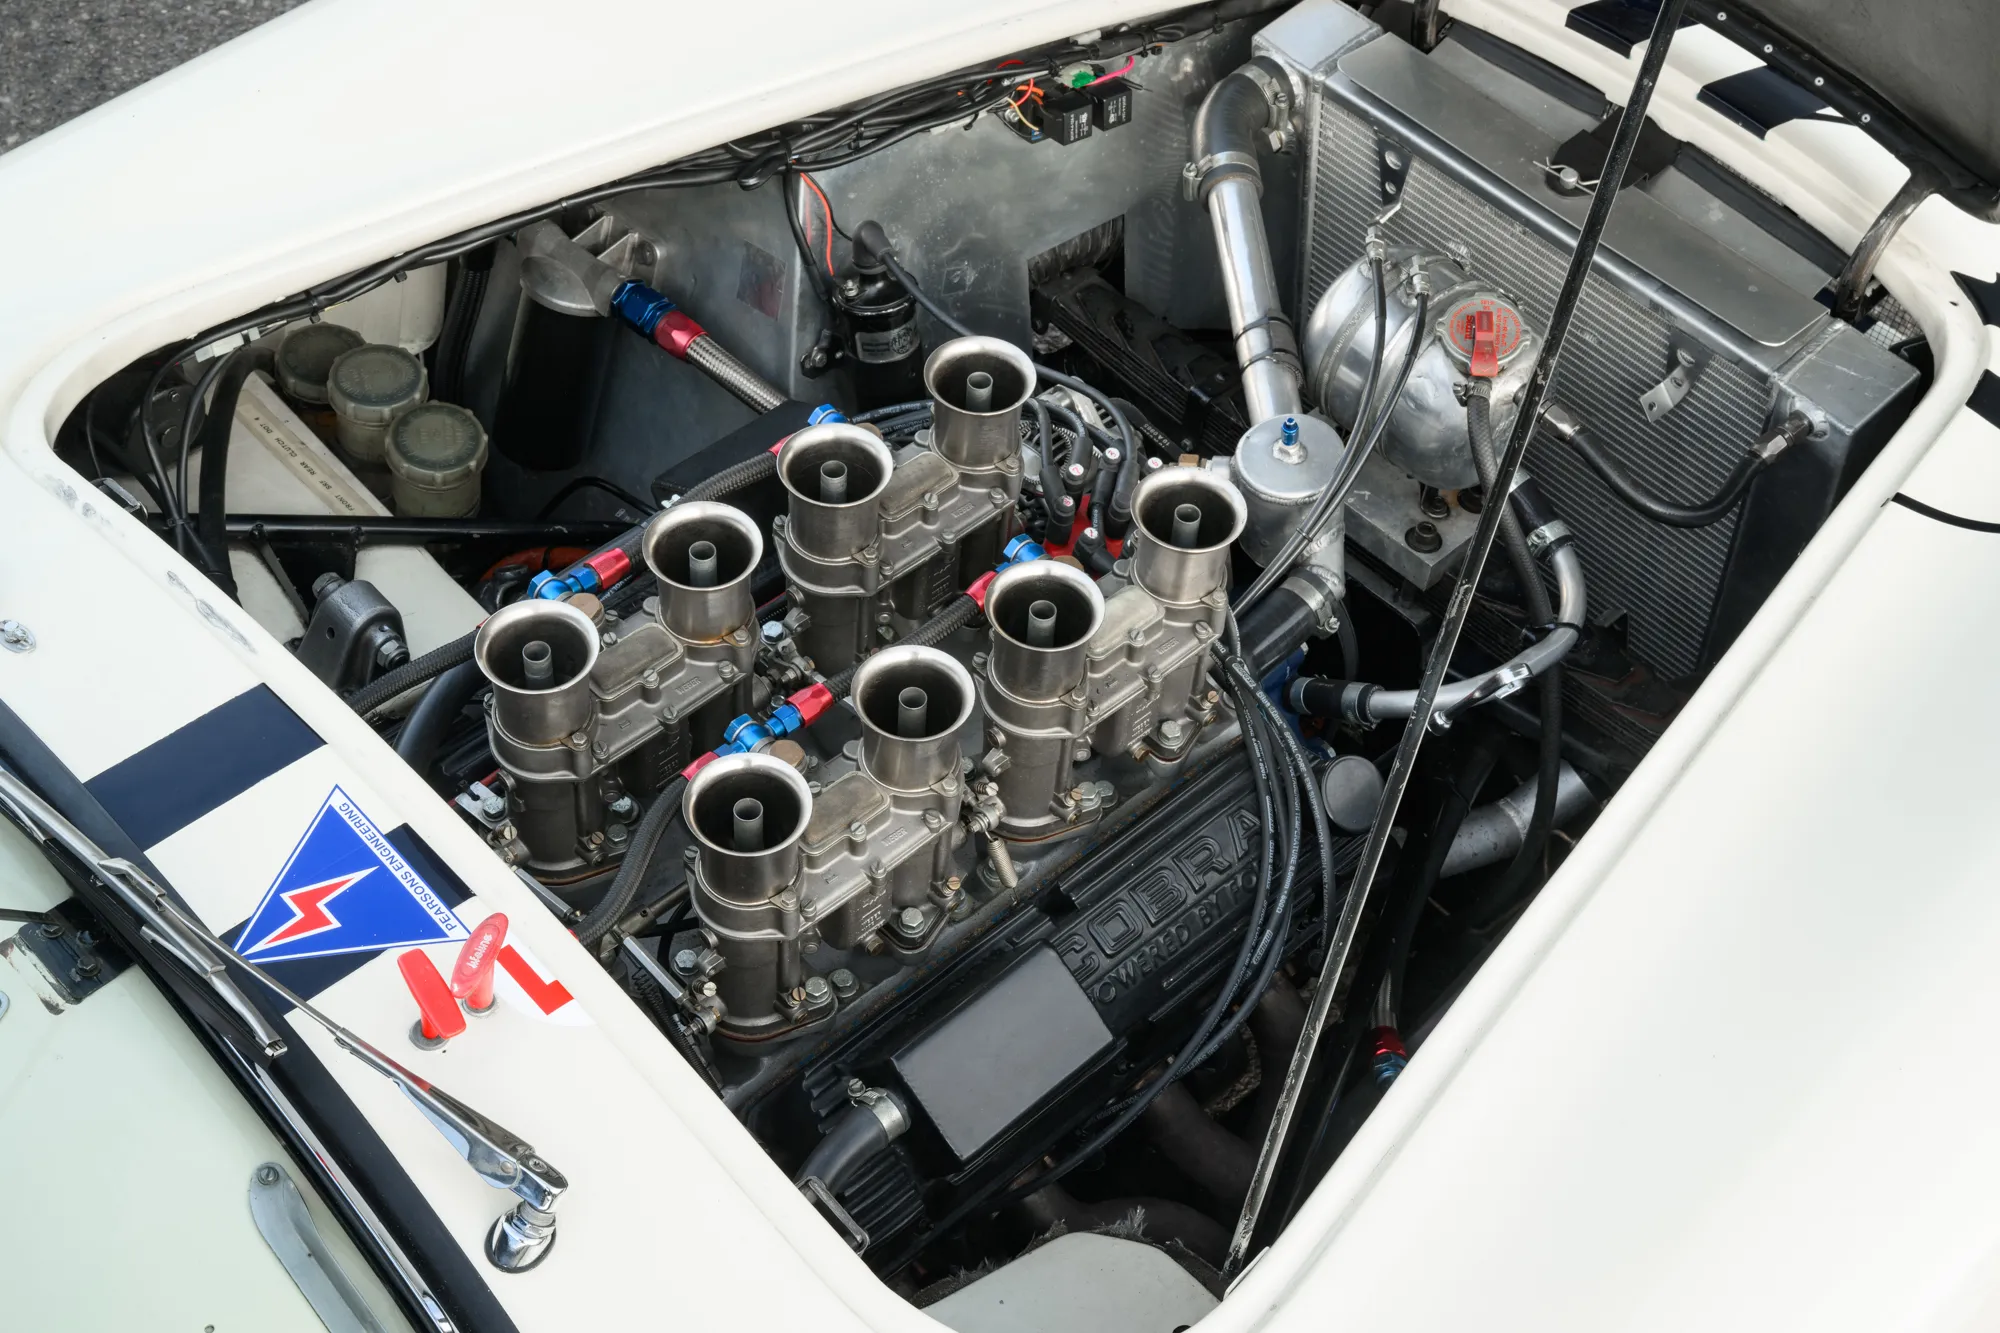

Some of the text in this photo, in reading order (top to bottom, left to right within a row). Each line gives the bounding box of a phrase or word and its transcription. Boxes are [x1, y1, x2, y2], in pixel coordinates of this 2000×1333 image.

[260, 422, 274, 434] DOT
[274, 438, 298, 458] CLUTCH
[300, 461, 316, 476] REAR
[334, 494, 355, 512] FRONT
[675, 677, 702, 696] WEBER
[1284, 732, 1300, 754] SPIRAL
[1295, 753, 1306, 772] CORE
[1304, 778, 1312, 790] EMI
[881, 826, 908, 847] WEBER
[338, 802, 458, 932] PEARSONS ENGINEERING
[1056, 807, 1261, 985] COBRA
[1091, 922, 1191, 1004] OWERED
[1196, 893, 1228, 926] BY
